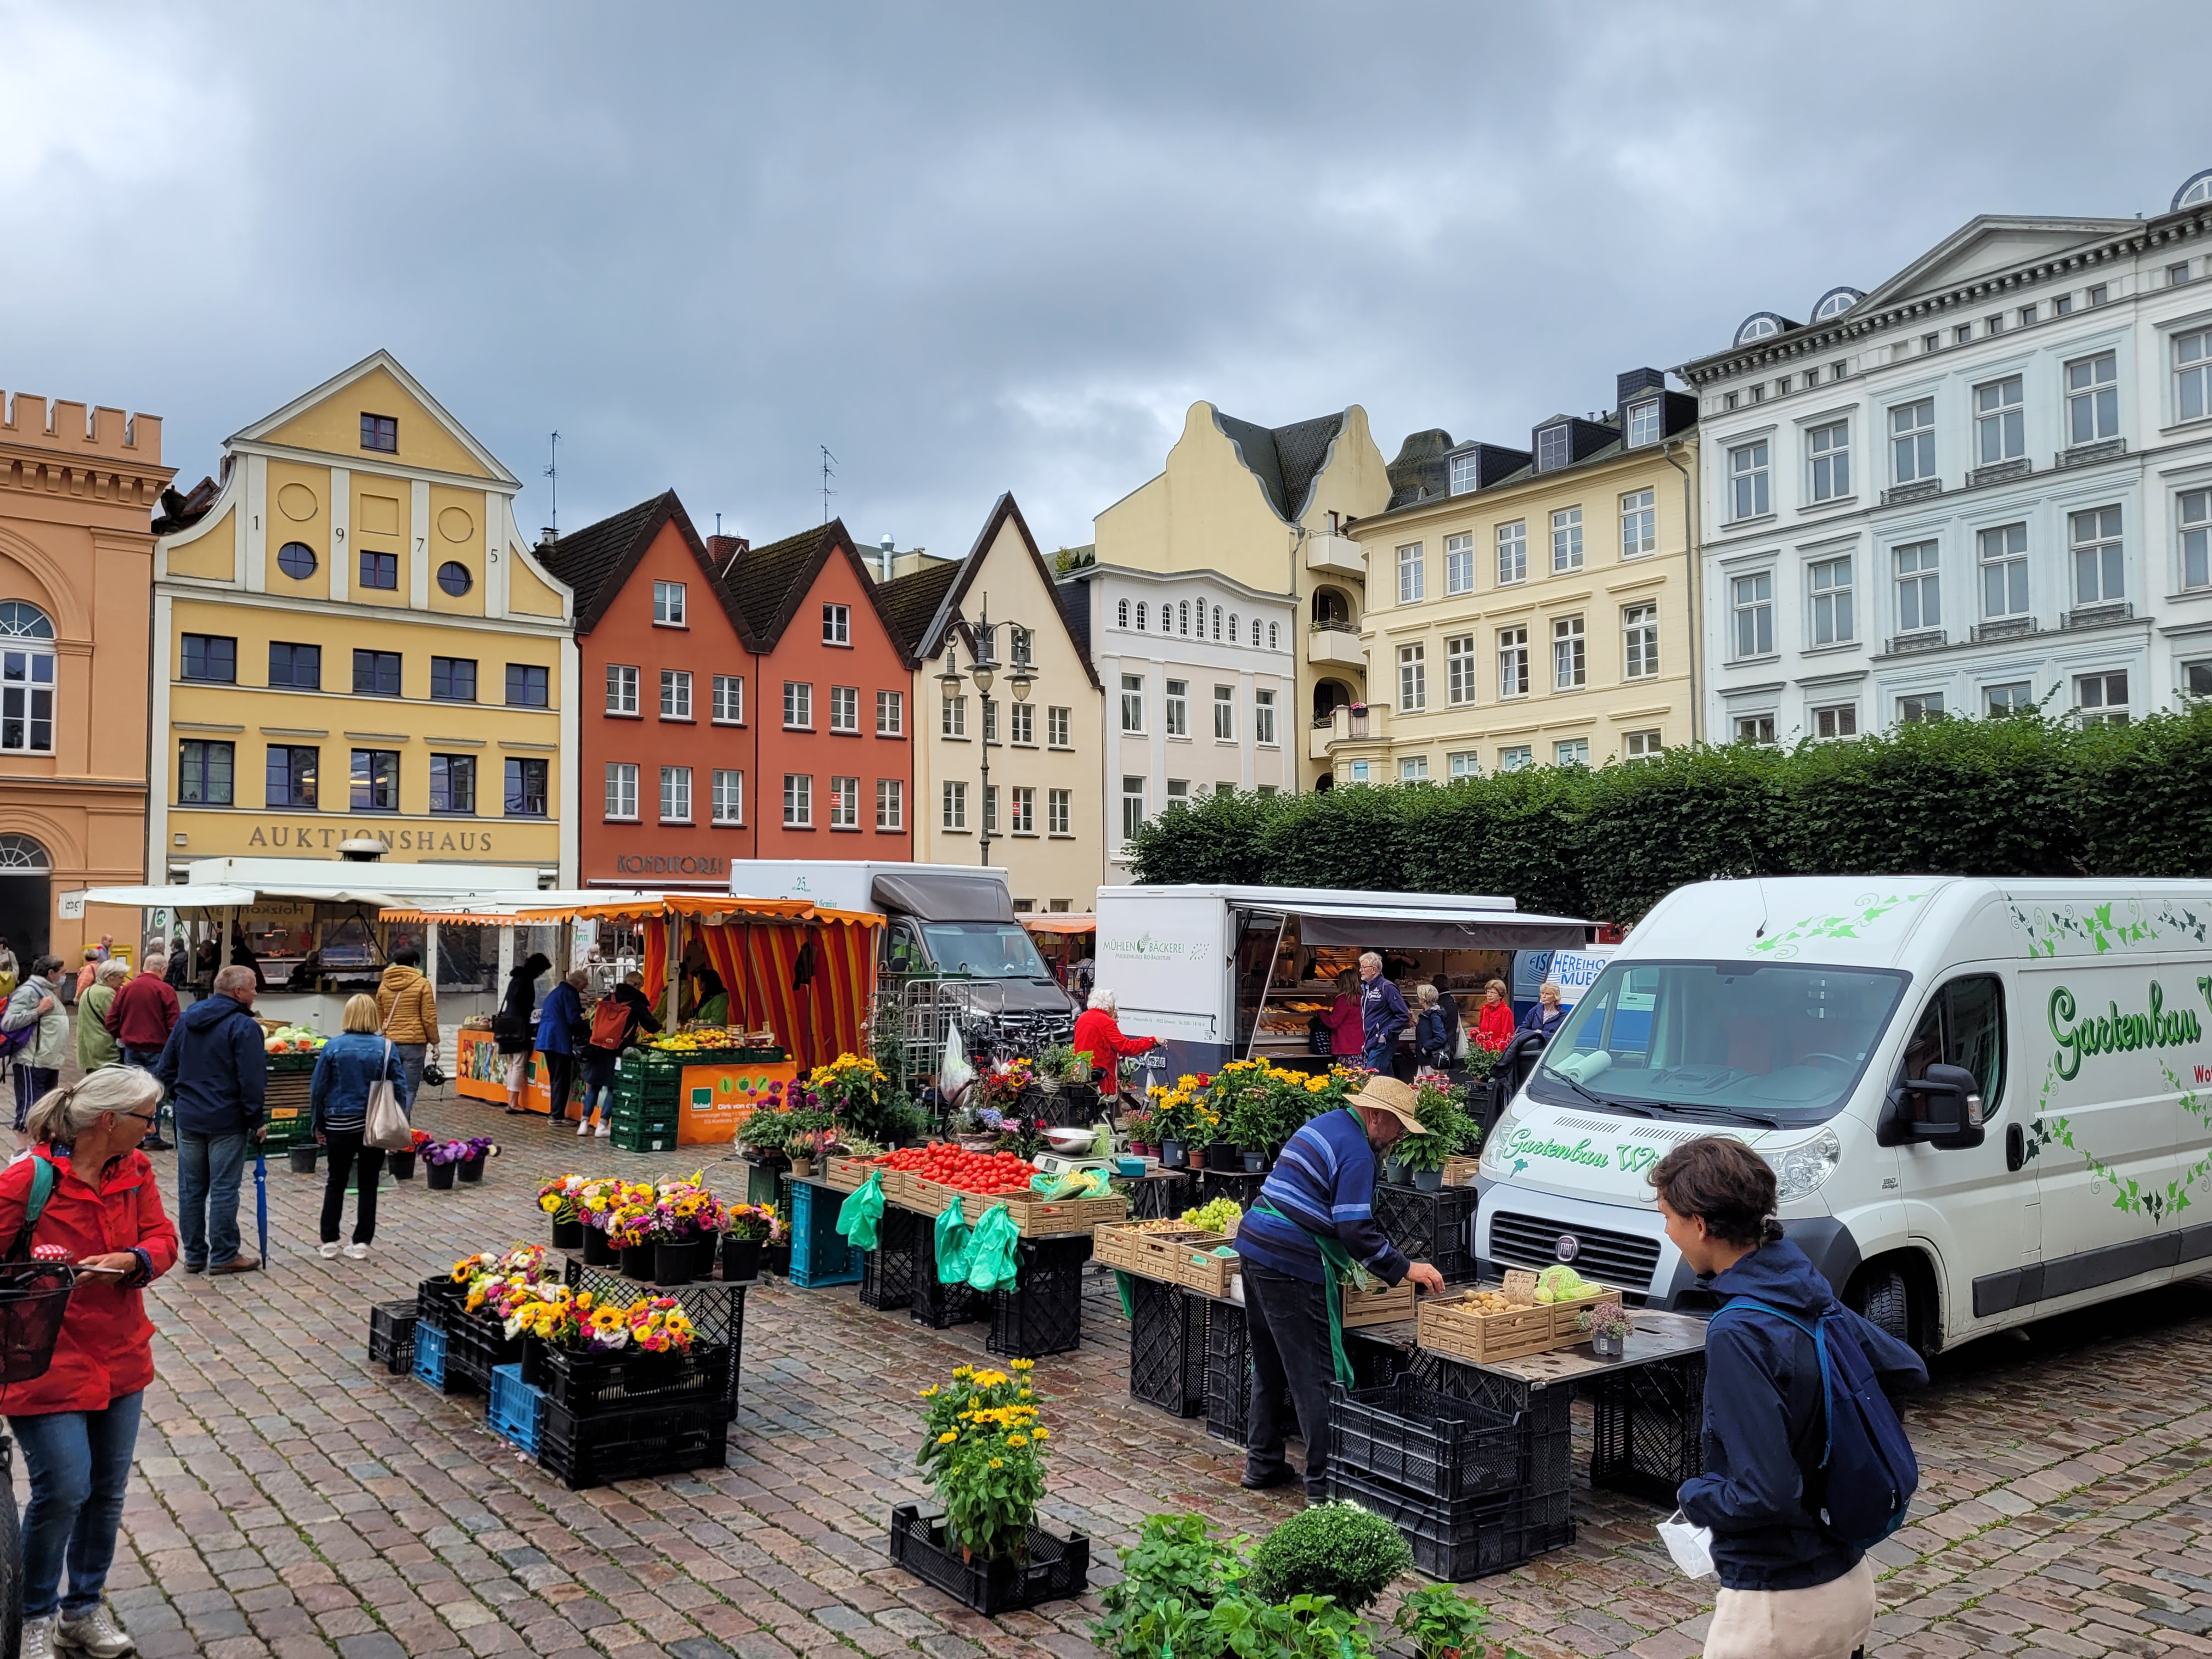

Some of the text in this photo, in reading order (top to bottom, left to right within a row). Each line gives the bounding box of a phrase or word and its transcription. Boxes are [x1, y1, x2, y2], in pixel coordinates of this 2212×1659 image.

[253, 515, 499, 563] 1 9 7 5
[618, 855, 723, 874] KONDITOREI
[796, 877, 806, 890] 25
[1103, 939, 1184, 953] MÜHLEN BÄCKEREI
[1530, 952, 1610, 973] FISCHEREIHO
[2047, 979, 2202, 1081] Gartenbau
[2193, 1064, 2212, 1084] Wo
[1502, 1128, 1660, 1173] Gartenbau Wi
[1560, 1243, 1573, 1256] FIAT
